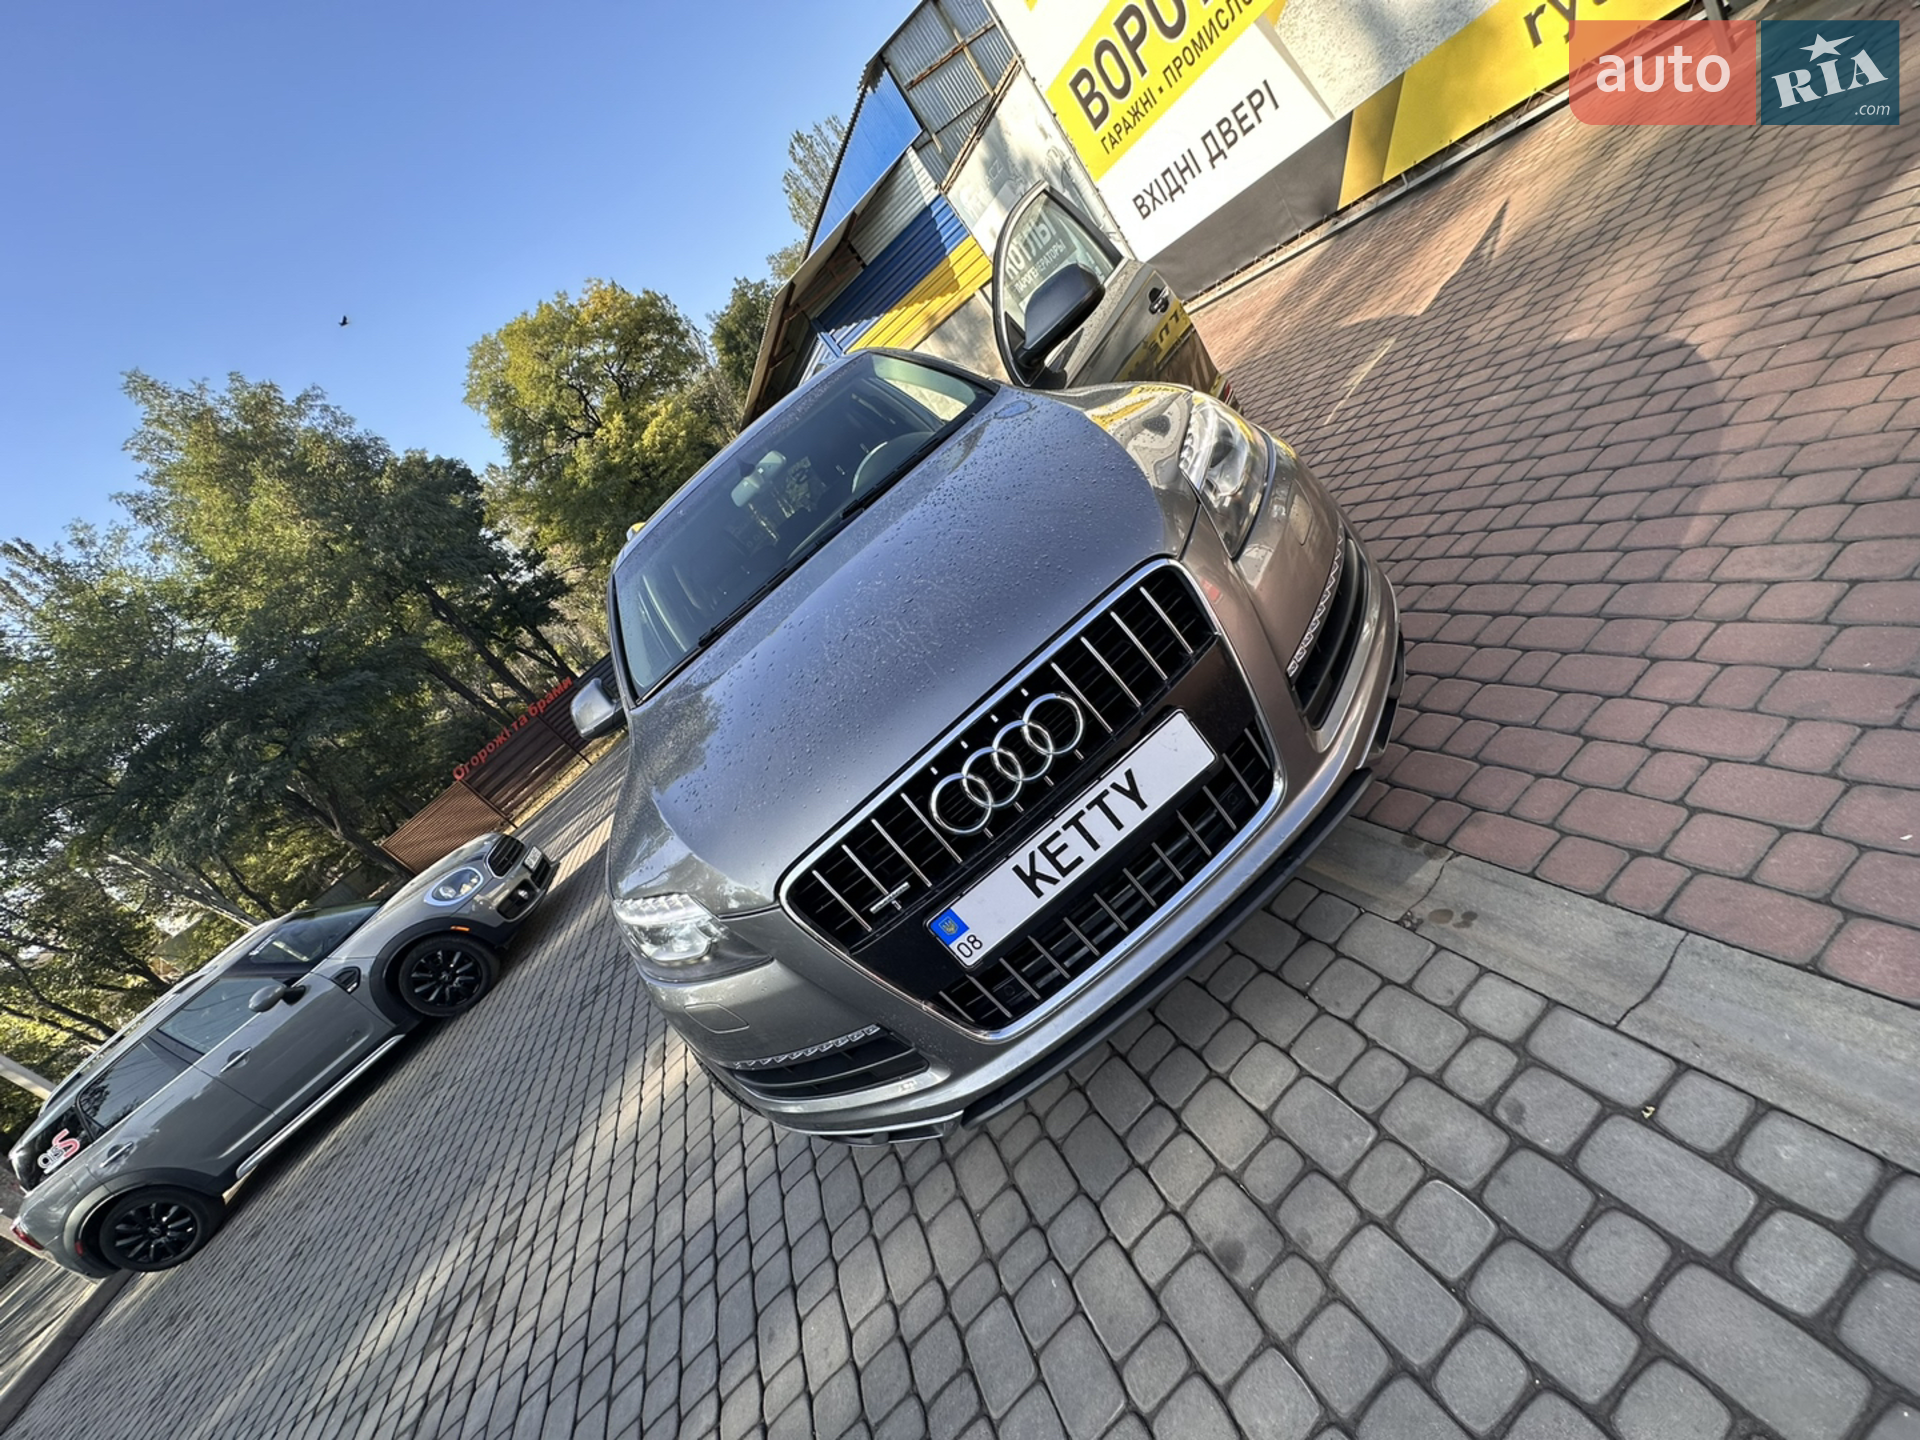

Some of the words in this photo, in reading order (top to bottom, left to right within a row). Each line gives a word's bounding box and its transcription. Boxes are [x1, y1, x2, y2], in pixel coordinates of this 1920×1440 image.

[1068, 0, 1209, 131] ВОРО
[1100, 87, 1158, 155] ГАРАЖНІ
[1162, 0, 1251, 89] ПРОМИСЛ
[1131, 148, 1203, 220] ВХІДНІ
[1200, 79, 1280, 168] ДВЕРІ
[453, 727, 512, 781] Огорожі
[511, 716, 529, 732] та
[528, 676, 574, 717] брами
[1011, 768, 1148, 899] KETTY
[956, 934, 983, 958] 08
